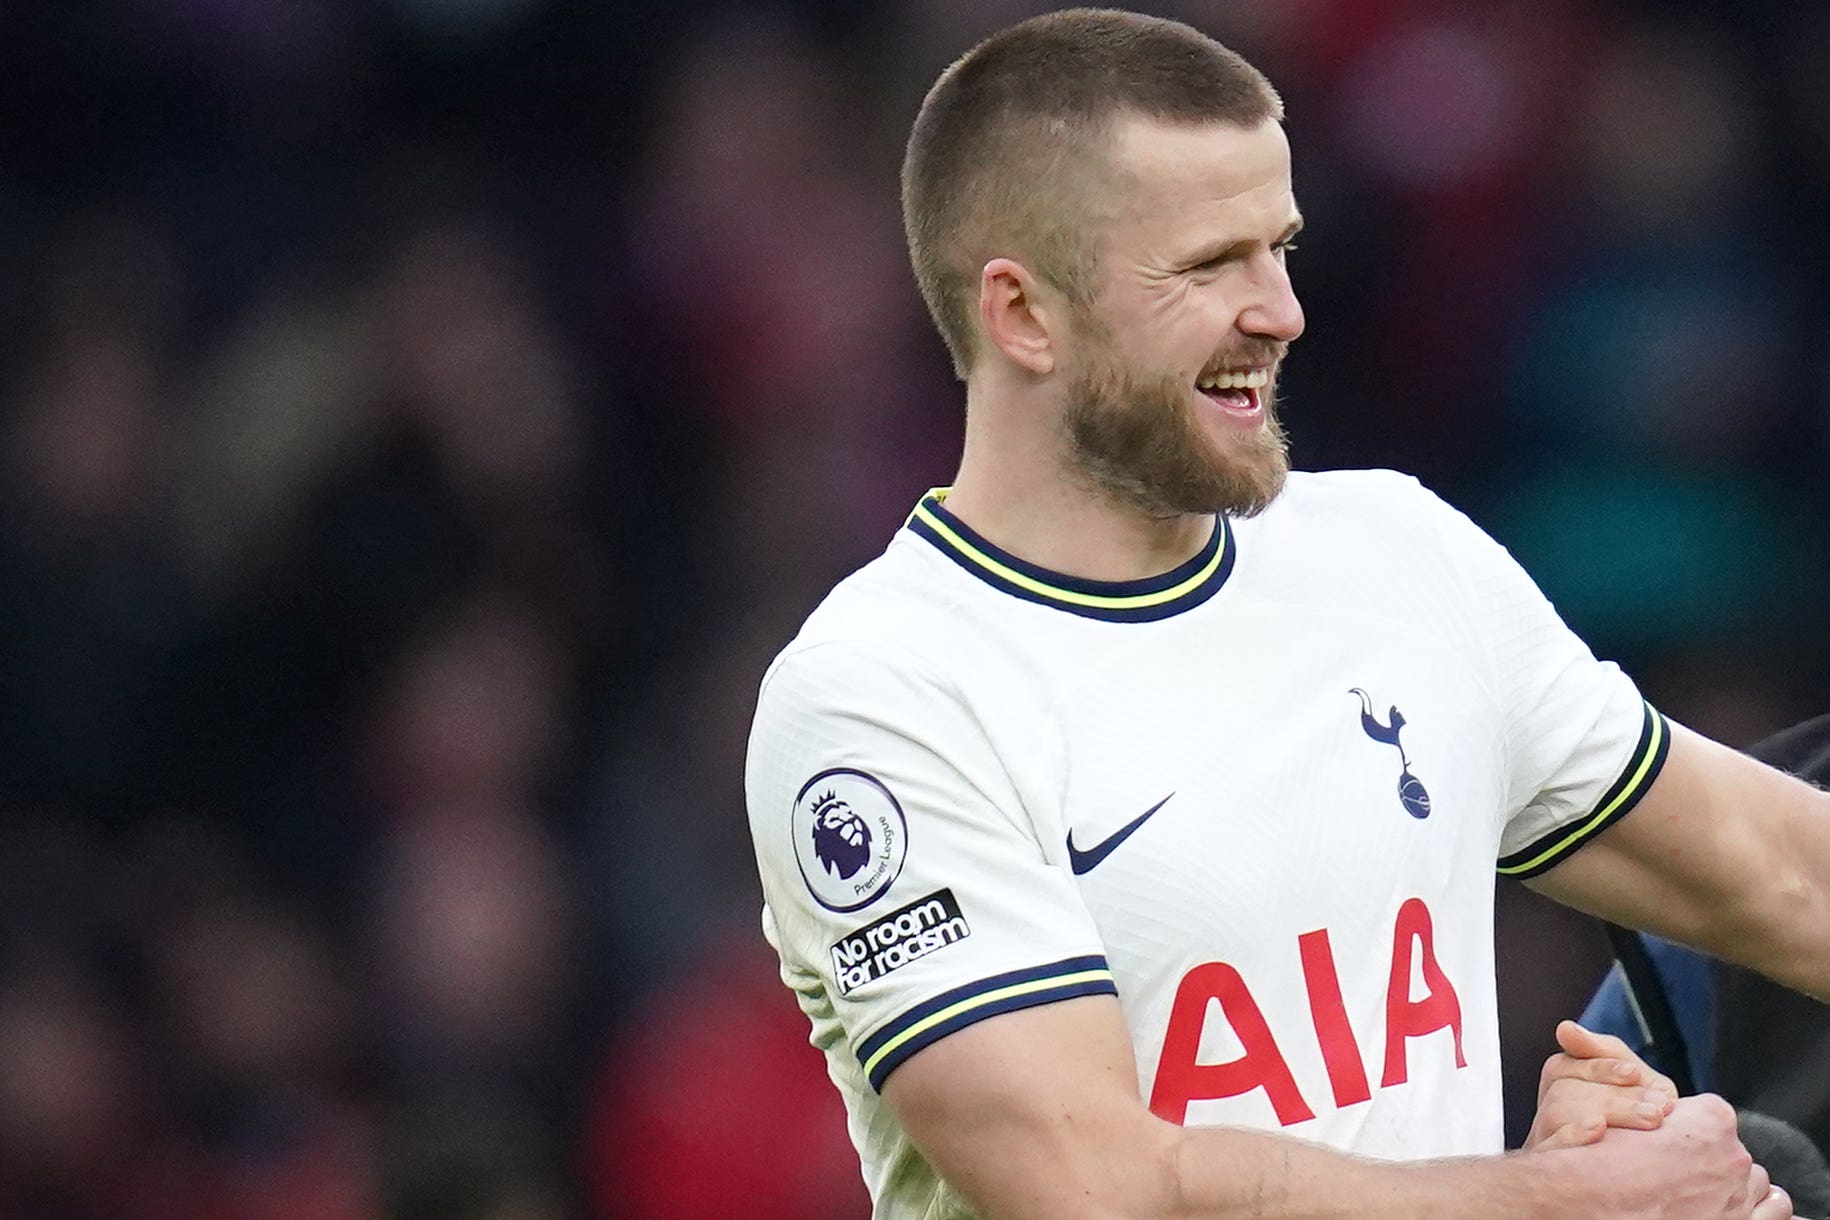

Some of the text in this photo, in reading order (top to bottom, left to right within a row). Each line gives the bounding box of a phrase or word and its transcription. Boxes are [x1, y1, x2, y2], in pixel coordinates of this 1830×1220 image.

[853, 816, 895, 896] Premier League
[831, 899, 947, 970] No room
[836, 917, 970, 994] for racism
[1148, 897, 1468, 1128] AIA
